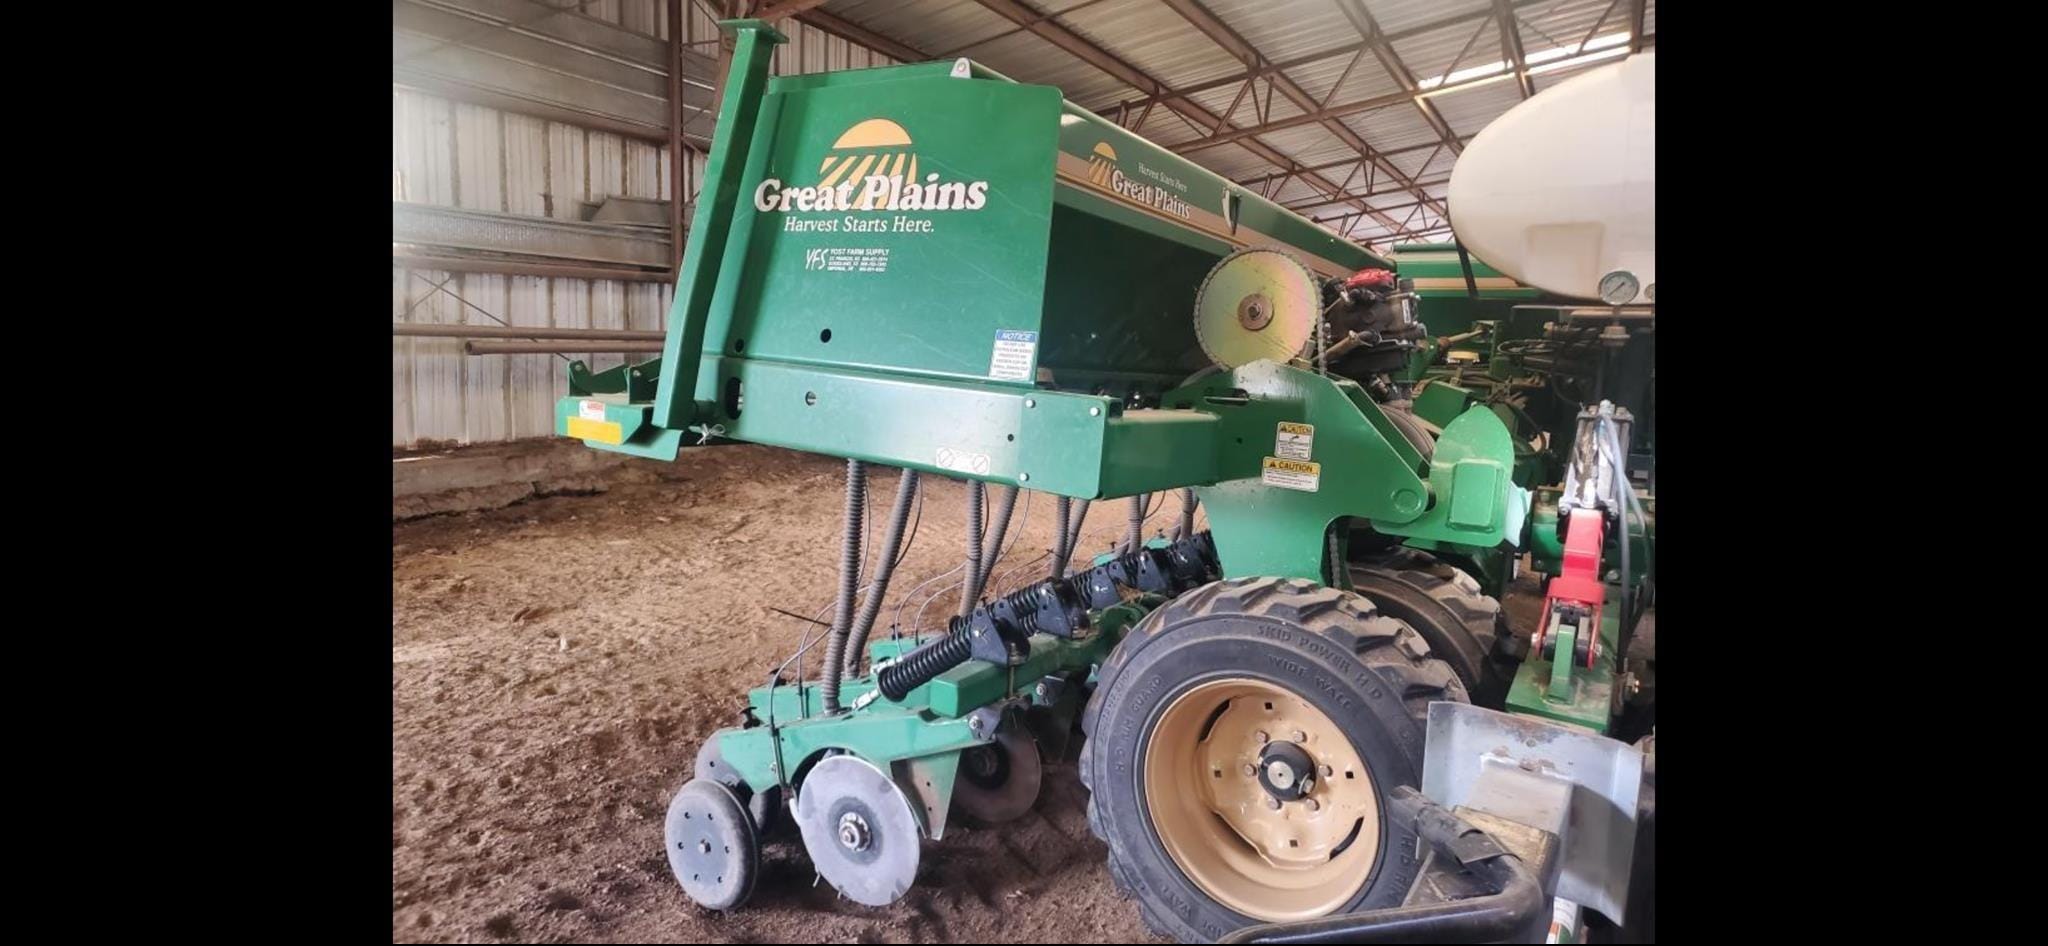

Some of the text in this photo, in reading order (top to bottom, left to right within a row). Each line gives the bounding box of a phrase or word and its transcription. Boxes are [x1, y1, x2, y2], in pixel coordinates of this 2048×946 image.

[754, 172, 988, 212] Great Plains
[1111, 169, 1190, 220] Great Plains
[784, 216, 935, 233] Harvest Starts Here.
[805, 248, 829, 271] YFS
[846, 248, 865, 256] FARM
[865, 248, 890, 257] SUPPLY
[1278, 461, 1313, 473] CAUTION
[1258, 624, 1292, 641] SKID
[1298, 638, 1352, 674] POWER
[1268, 654, 1352, 709] WIDE WALL
